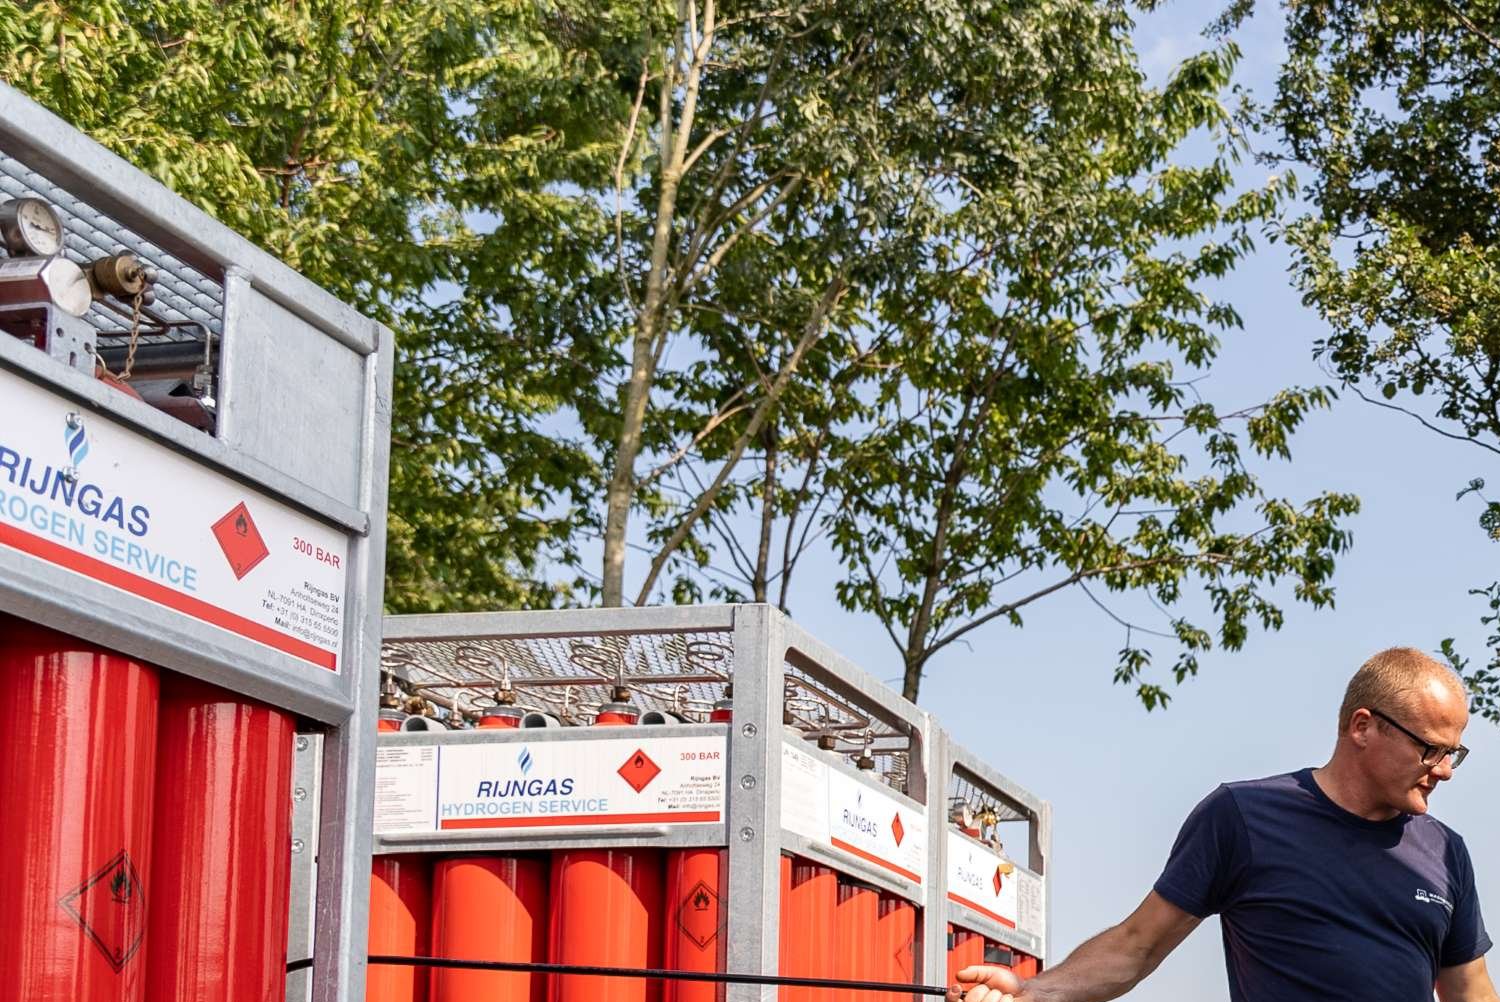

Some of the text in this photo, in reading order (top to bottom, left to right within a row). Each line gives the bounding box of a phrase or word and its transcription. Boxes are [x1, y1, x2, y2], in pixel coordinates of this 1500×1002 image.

[0, 444, 150, 537] RIJNGAS
[94, 530, 197, 591] SERVICE
[293, 537, 340, 569] 300 BAR
[304, 581, 329, 600] Rijngas
[680, 751, 720, 761] 300 BAR
[477, 778, 574, 798] RIJNGAS
[441, 798, 609, 816] HYDROGEN SERVICE
[843, 808, 878, 838] RIJNGAS
